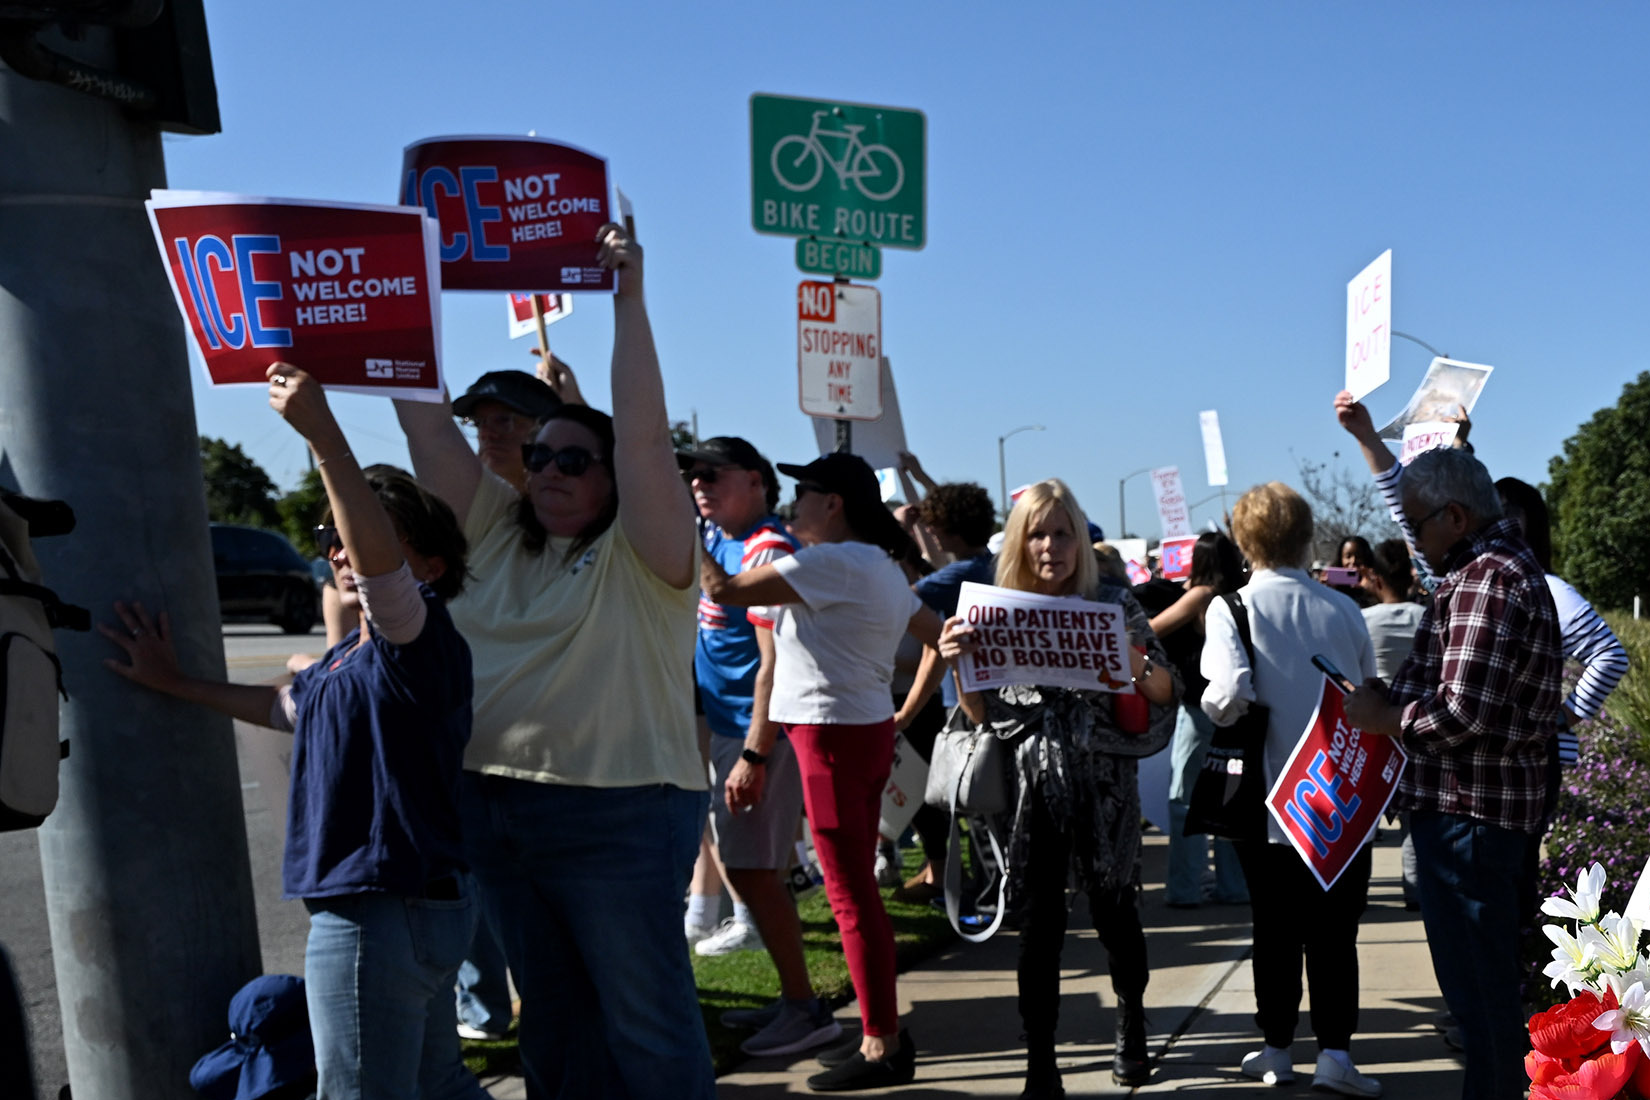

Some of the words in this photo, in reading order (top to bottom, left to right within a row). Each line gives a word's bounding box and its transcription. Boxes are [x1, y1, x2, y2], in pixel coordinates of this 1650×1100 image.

[504, 173, 561, 203] NOT
[507, 198, 601, 223] WELCOME
[763, 199, 821, 230] BIKE
[835, 207, 915, 242] ROUTE
[511, 220, 563, 243] HERE!
[289, 247, 366, 279] NOT
[804, 242, 873, 273] BEGIN
[174, 234, 293, 349] ICE
[292, 275, 417, 300] WELCOME
[801, 286, 832, 318] NO
[1354, 274, 1383, 324] ICE
[295, 302, 368, 326] HERE!
[803, 328, 876, 359] STOPPING
[827, 360, 852, 380] ANY
[828, 383, 853, 404] TIME
[968, 605, 1008, 627] OUR
[968, 628, 1052, 649] RIGHTS
[1057, 632, 1118, 652] HAVE
[973, 648, 1006, 669] NO
[1013, 650, 1123, 672] BORDERS
[1327, 717, 1349, 765] NOT
[1339, 727, 1362, 774] WELCO
[1349, 746, 1368, 787] HERE!
[1284, 749, 1362, 859] ICE
